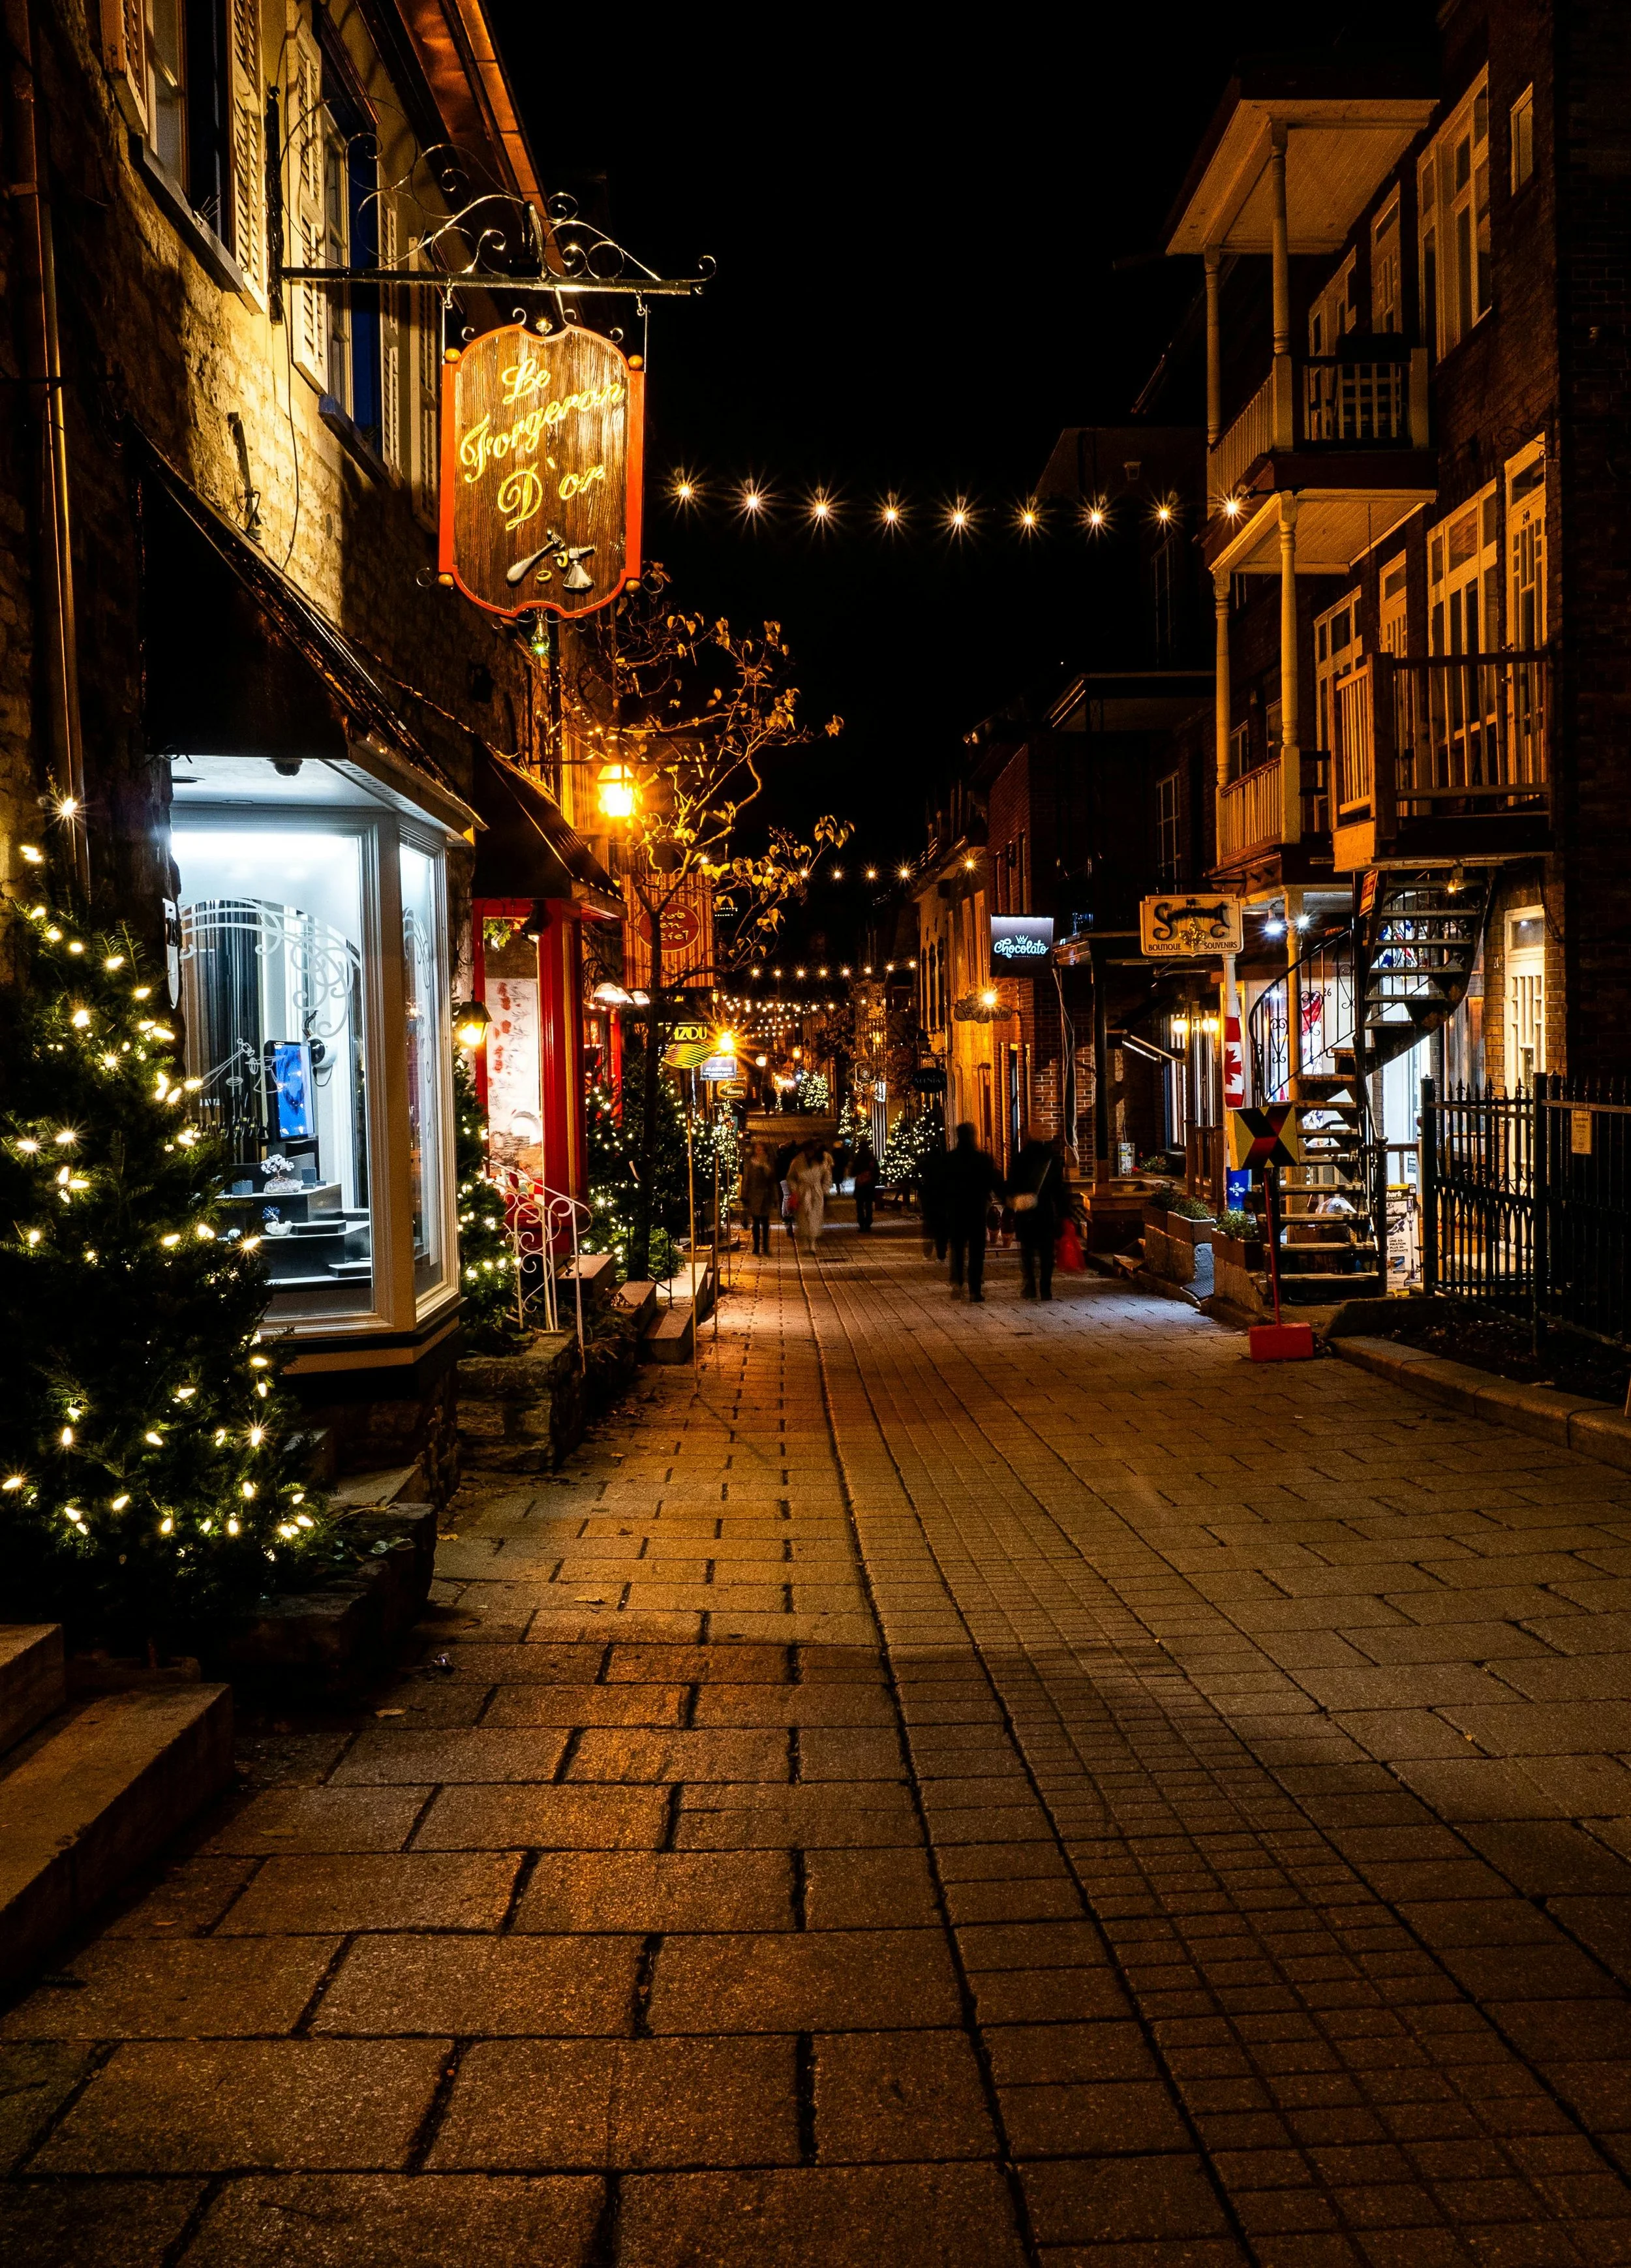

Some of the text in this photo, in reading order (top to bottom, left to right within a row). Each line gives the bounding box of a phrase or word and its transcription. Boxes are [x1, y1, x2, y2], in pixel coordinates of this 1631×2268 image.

[501, 358, 551, 405] Le
[460, 383, 625, 483] Forgeron
[994, 938, 1049, 958] Chocolato
[1204, 941, 1237, 949] SOUVENIRS
